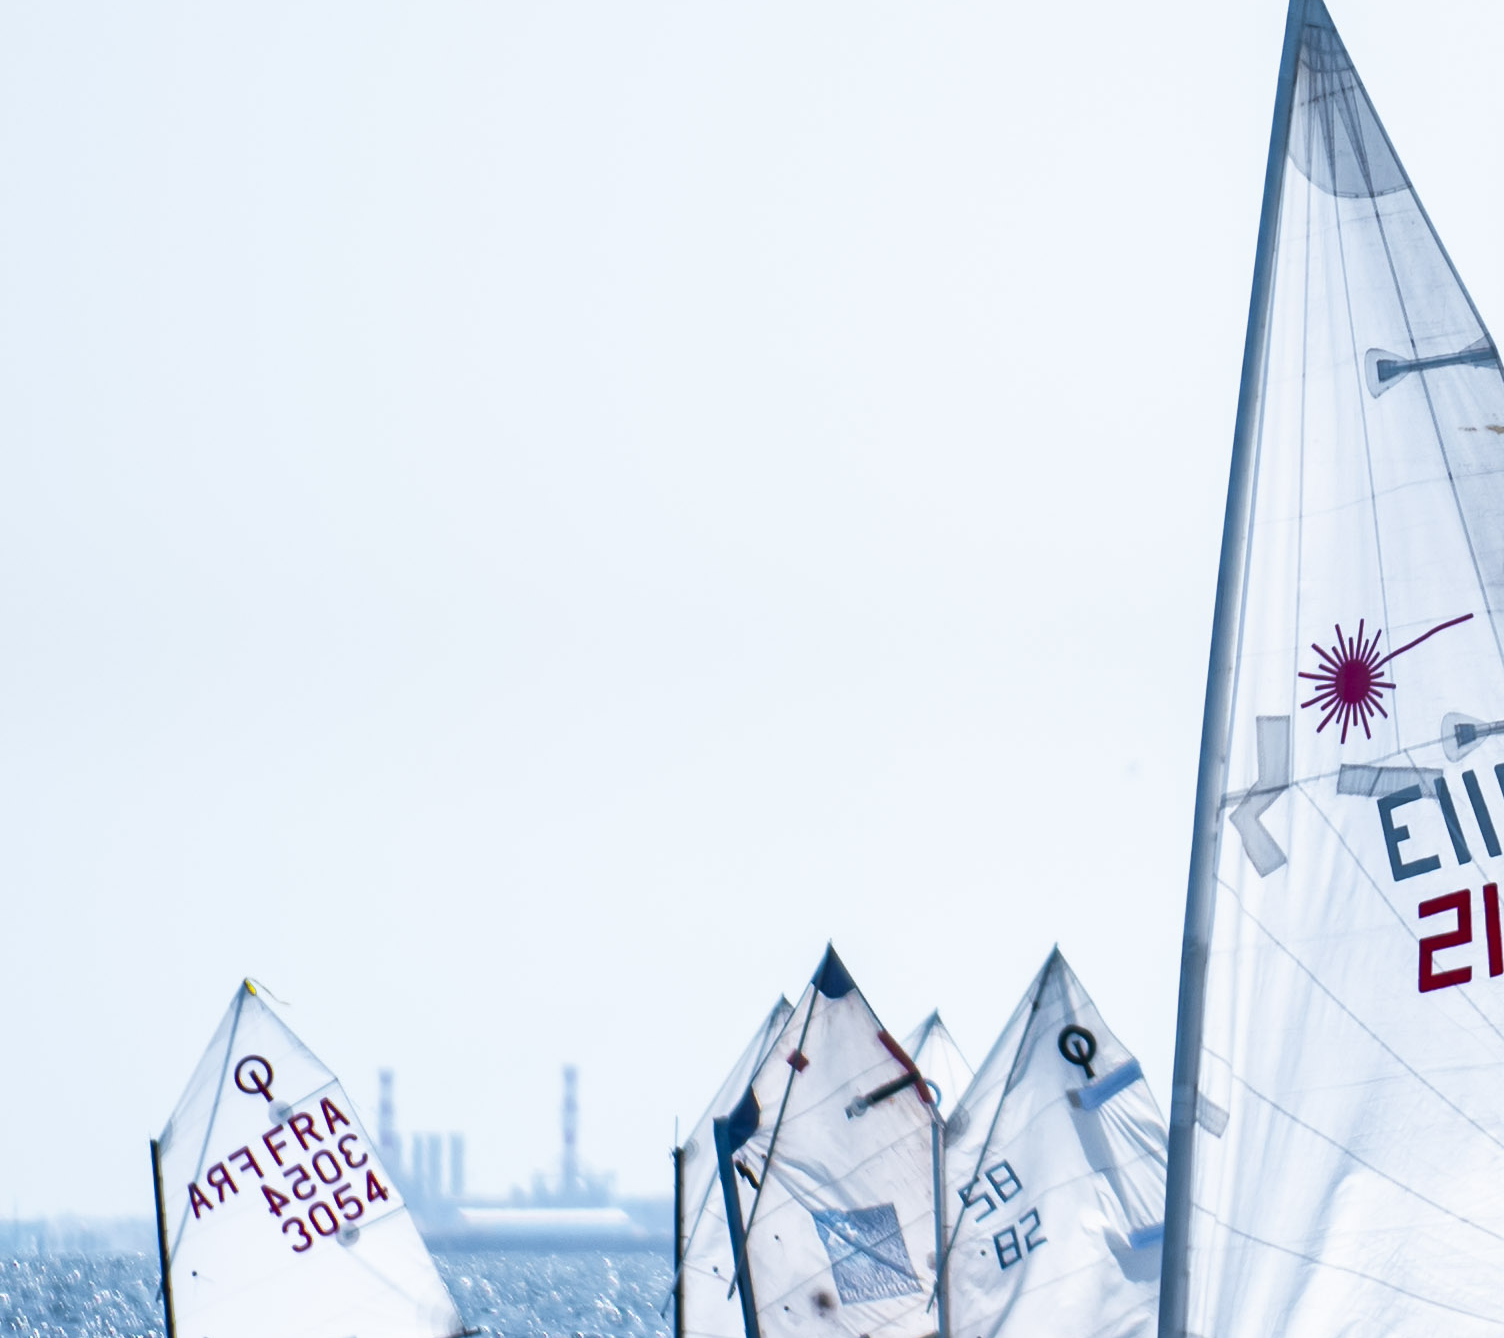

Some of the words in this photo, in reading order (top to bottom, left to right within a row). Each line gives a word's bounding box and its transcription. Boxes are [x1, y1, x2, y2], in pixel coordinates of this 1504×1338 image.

[262, 1097, 351, 1167] FRA
[281, 1169, 389, 1253] 3054
[993, 1207, 1048, 1271] 82
